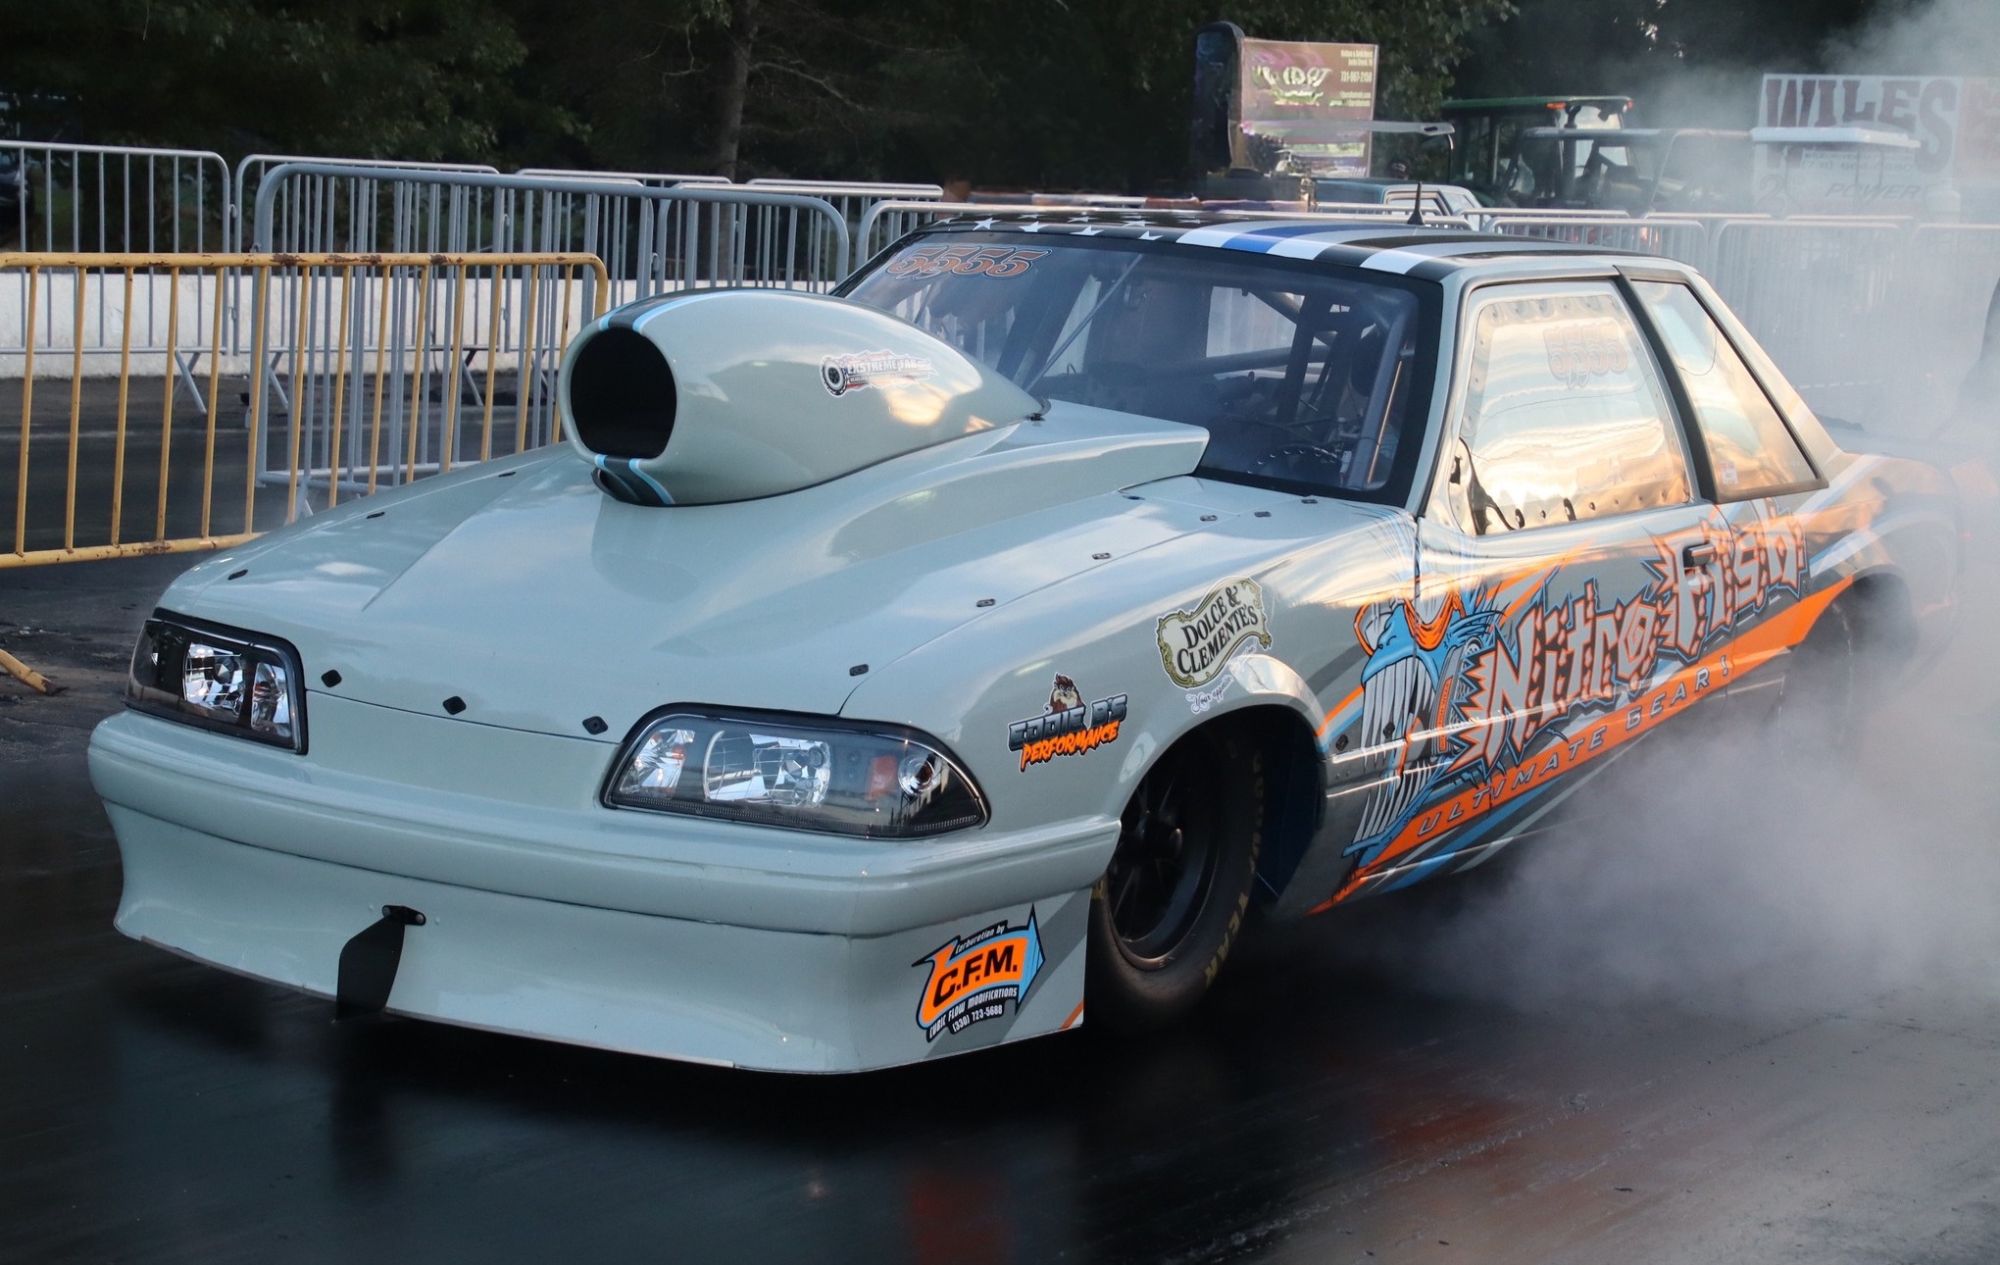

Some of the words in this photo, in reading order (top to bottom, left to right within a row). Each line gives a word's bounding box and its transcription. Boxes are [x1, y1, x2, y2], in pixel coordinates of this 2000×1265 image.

[1765, 78, 1957, 173] WILES
[1824, 182, 1921, 202] POWER
[1648, 497, 1806, 656] Fish
[1177, 603, 1259, 675] CLEMENTE'S
[1181, 596, 1228, 650] DOLCE
[1225, 585, 1242, 608] &
[1450, 579, 1666, 772] Nitro
[1009, 705, 1086, 751] EDDIE
[1020, 719, 1119, 772] PERFORMANCE
[1416, 726, 1607, 837] ULTIMATE
[933, 945, 1018, 1008] C.F.M.
[948, 1001, 967, 1023] FLOW
[967, 987, 1018, 1010] MODIFICATIONS
